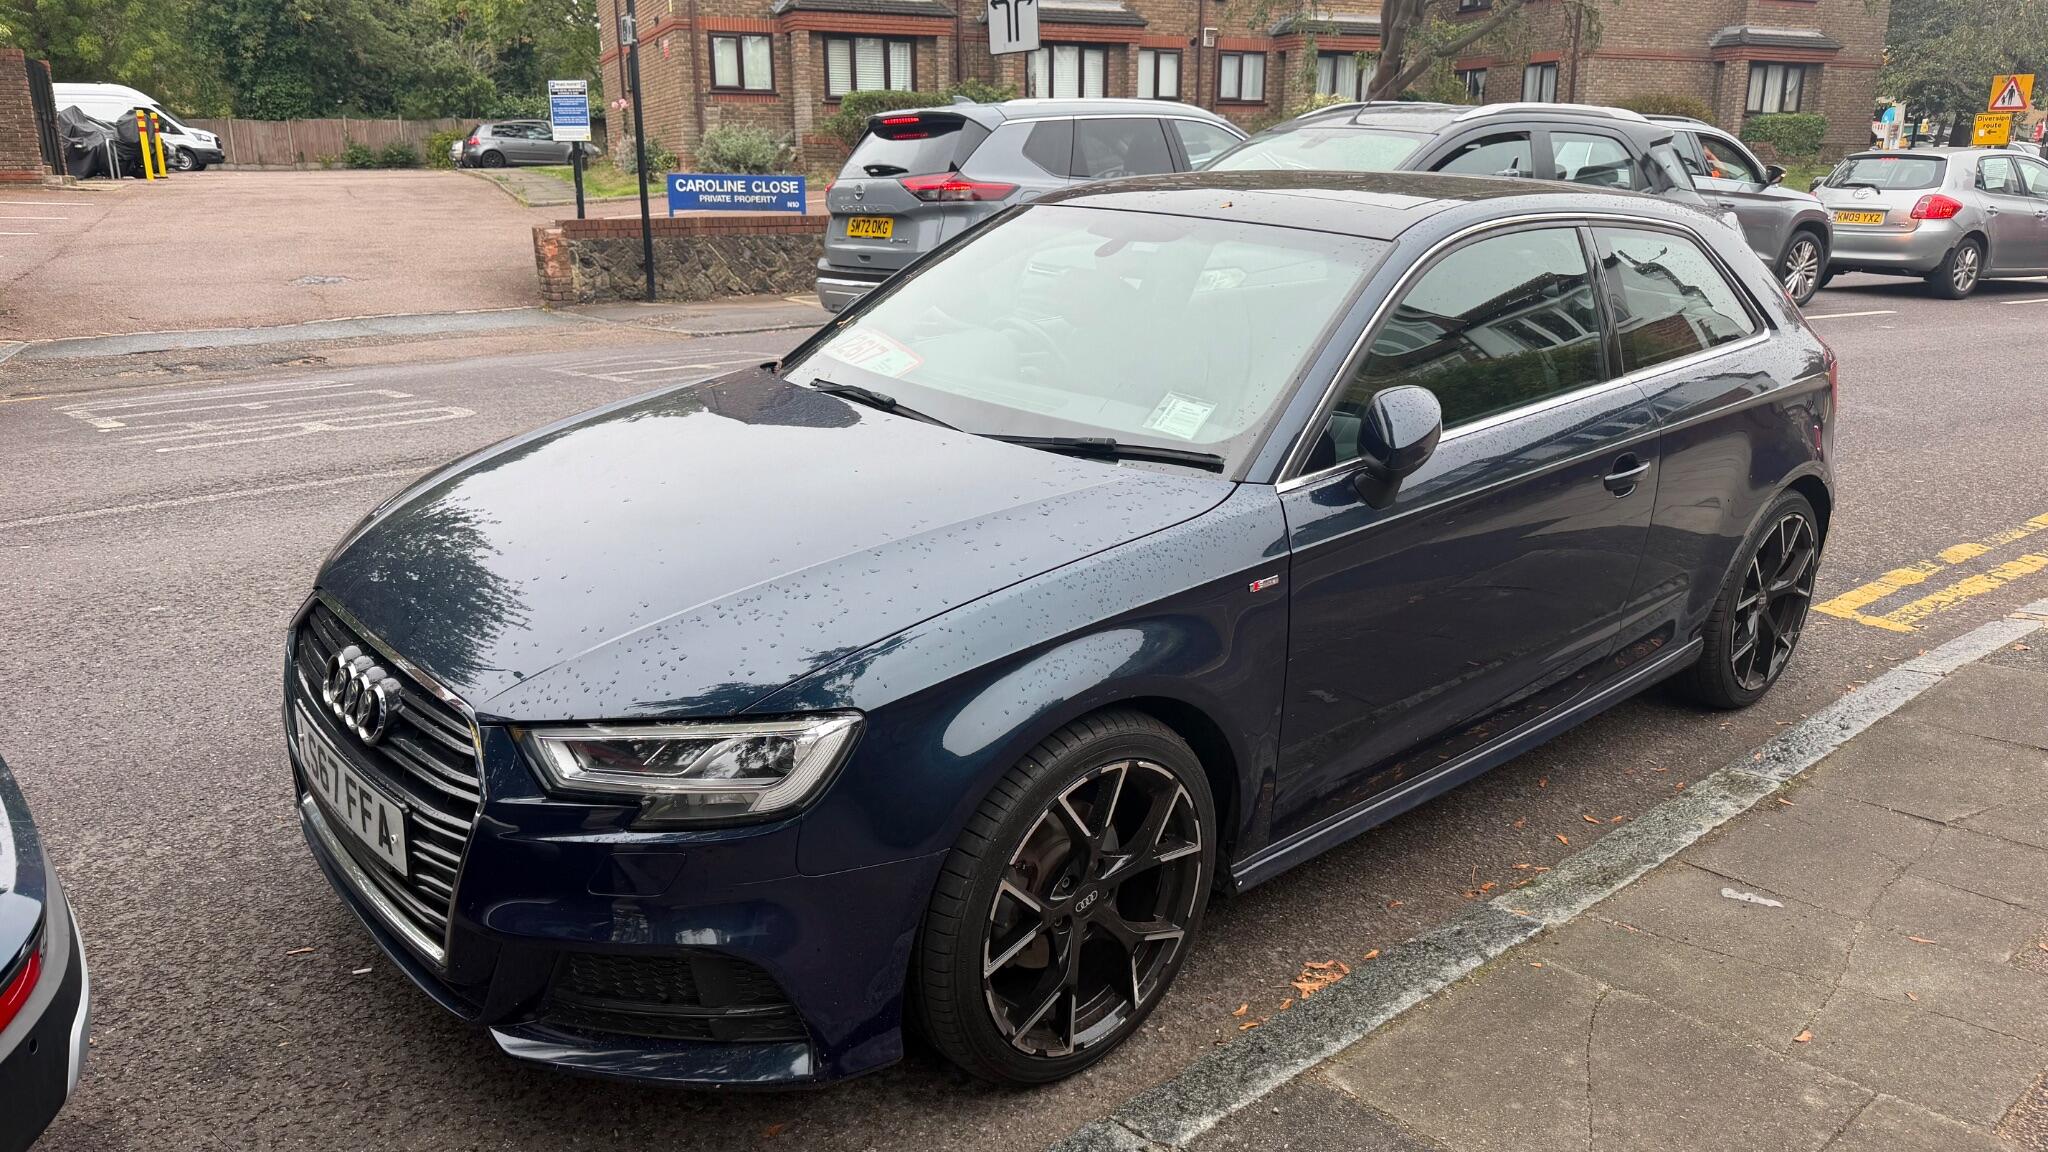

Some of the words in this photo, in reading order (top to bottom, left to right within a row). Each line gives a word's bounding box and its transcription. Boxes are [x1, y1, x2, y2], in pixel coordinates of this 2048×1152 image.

[675, 179, 746, 192] CAROLINE
[752, 181, 799, 193] CLOSE
[699, 194, 731, 203] PRIVATE
[734, 195, 777, 204] PROPERTY
[1837, 211, 1861, 222] KM09
[1863, 213, 1881, 223] YXZ
[872, 220, 889, 234] OKG
[345, 772, 394, 857] FFA
